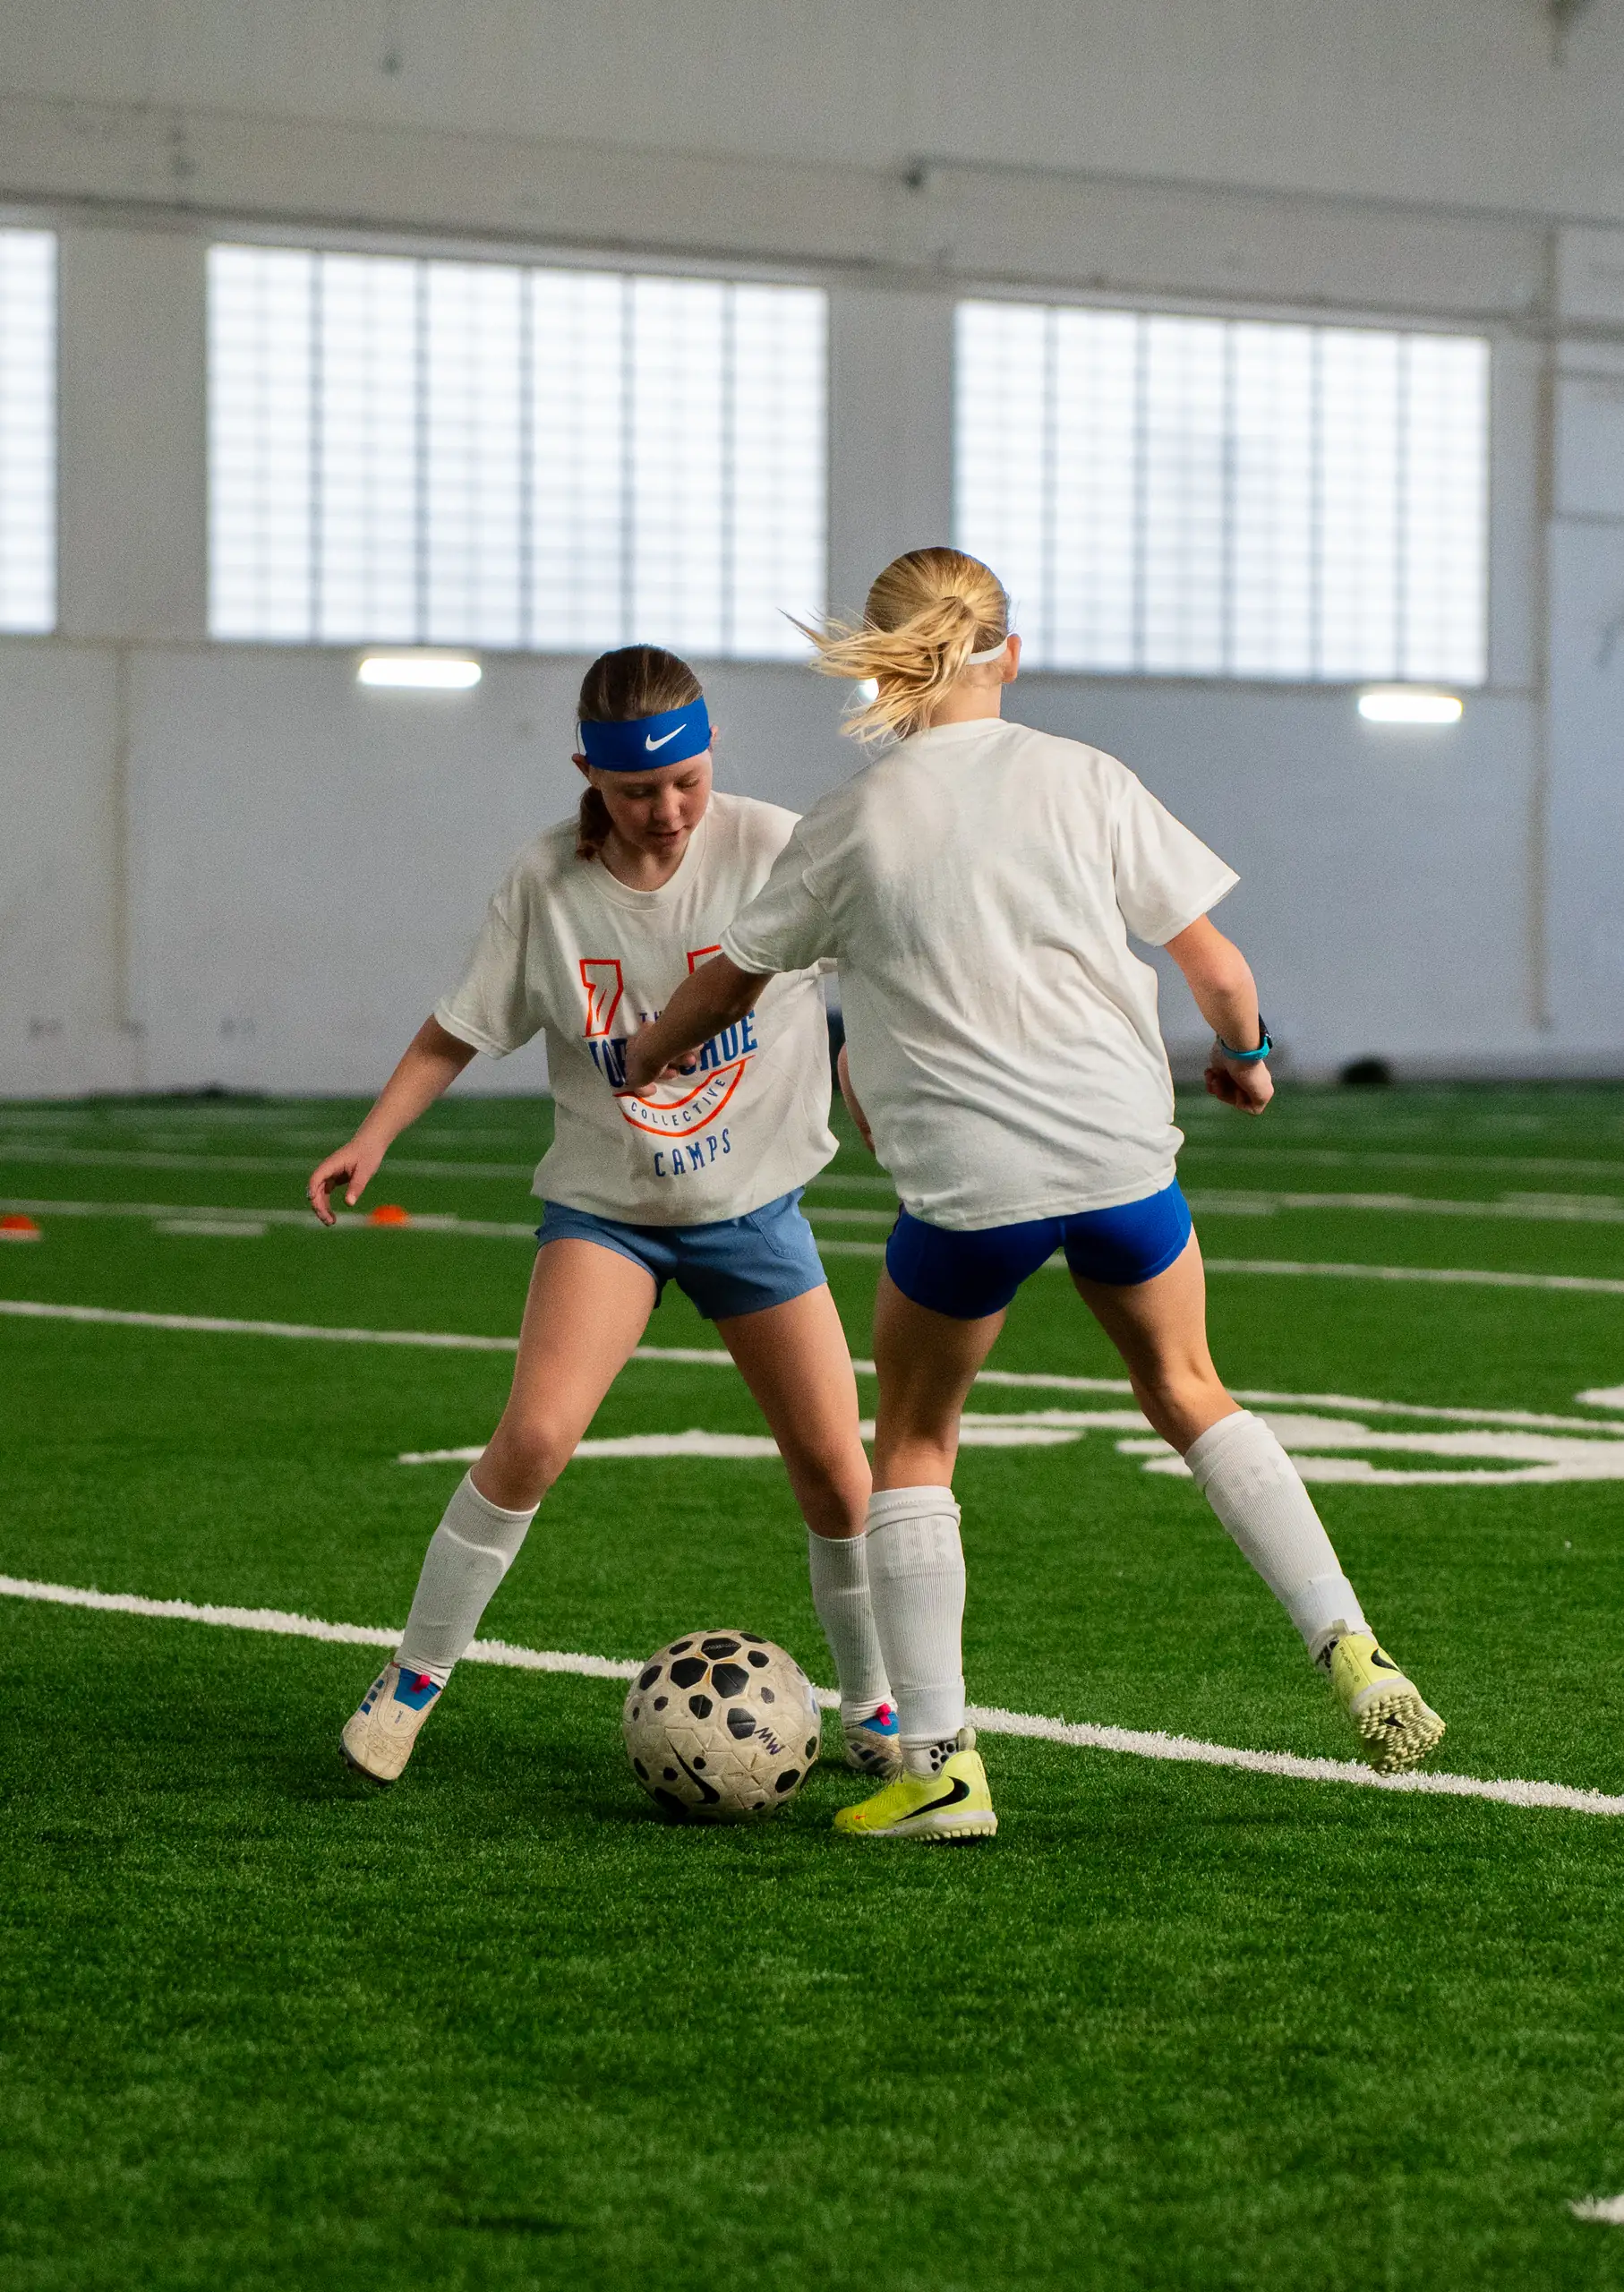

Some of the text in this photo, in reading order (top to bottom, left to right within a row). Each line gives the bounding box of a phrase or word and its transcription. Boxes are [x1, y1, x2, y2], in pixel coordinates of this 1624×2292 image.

[630, 1078, 726, 1126] COLLECTIVE
[654, 1127, 731, 1177] CAMPS
[753, 1726, 786, 1756] MW
